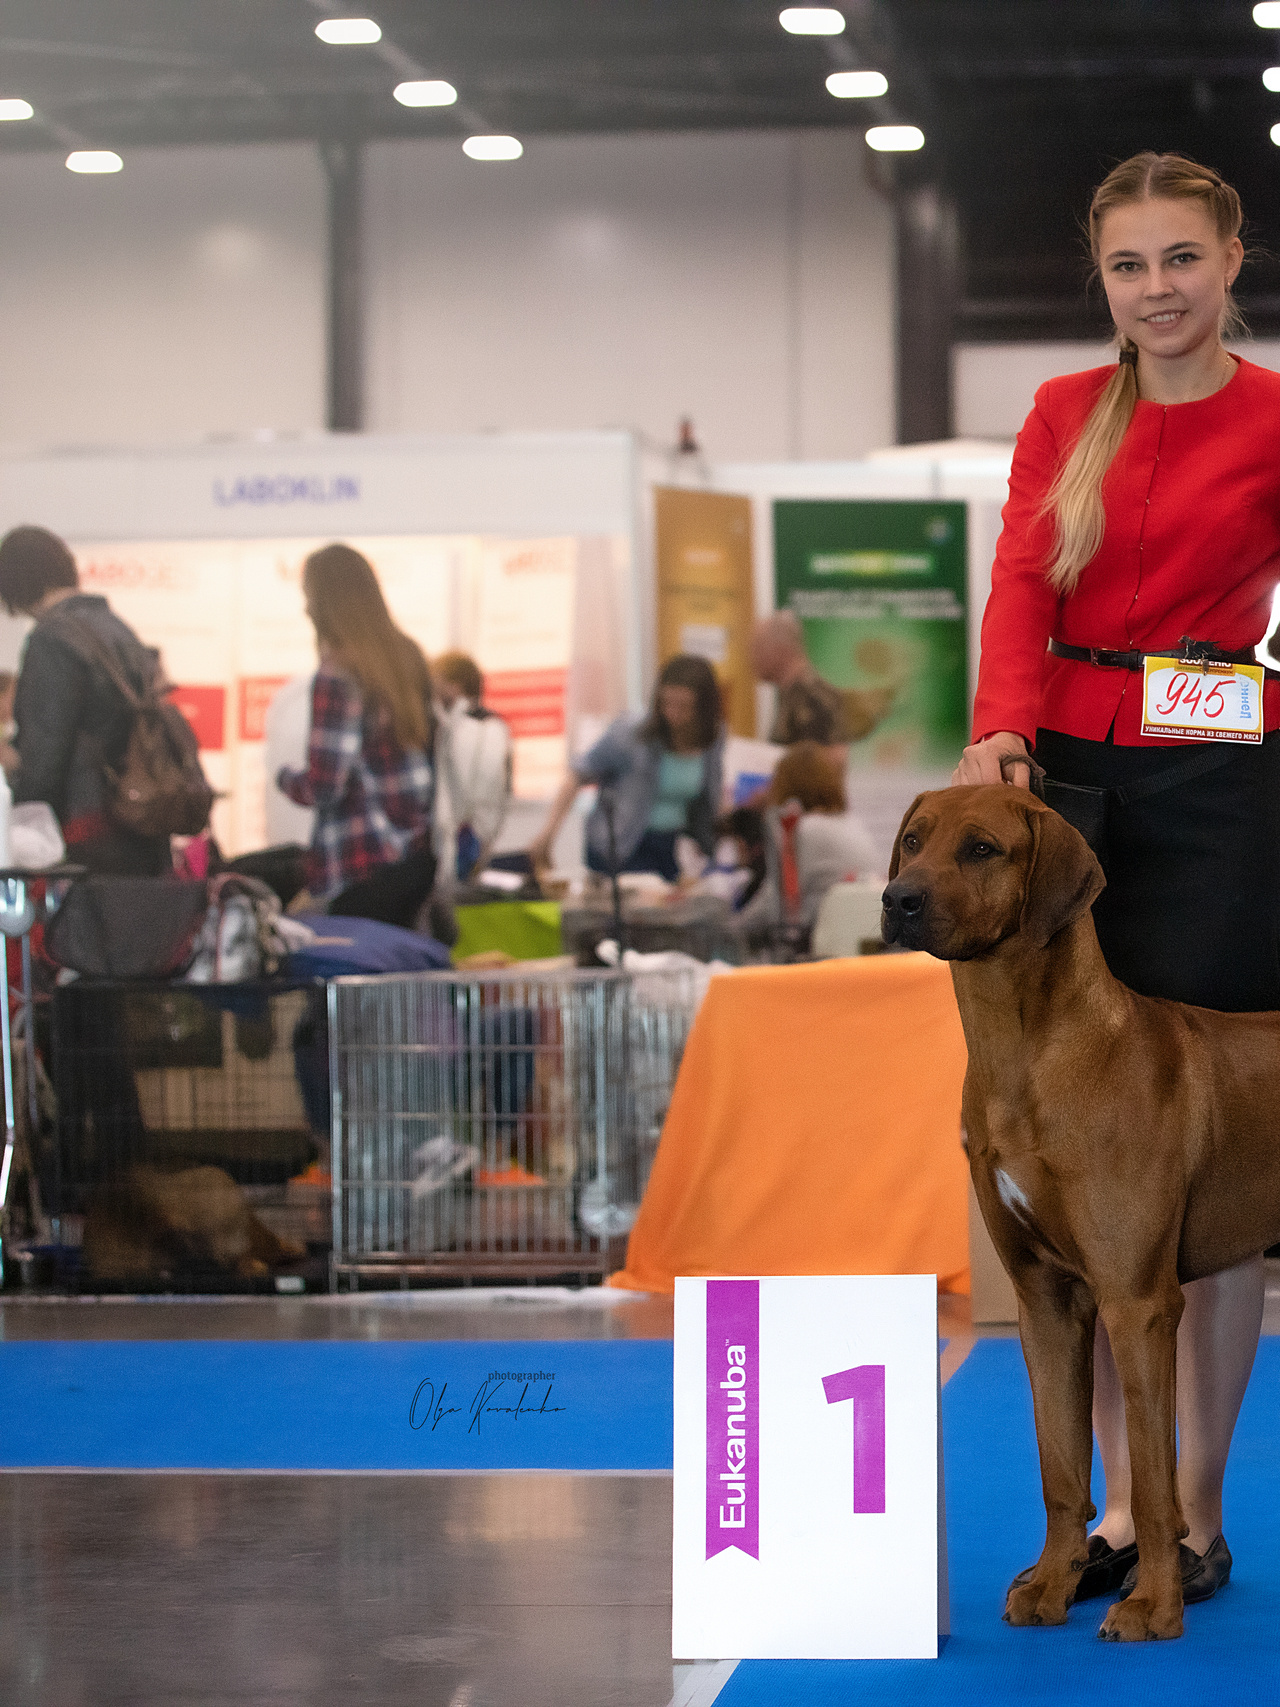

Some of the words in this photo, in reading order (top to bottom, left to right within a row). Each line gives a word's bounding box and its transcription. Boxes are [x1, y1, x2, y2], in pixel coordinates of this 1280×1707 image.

[213, 475, 361, 507] LABOKLIN
[1156, 672, 1236, 718] 945
[1145, 726, 1185, 734] УНИКАЛЬНЫЕ
[1186, 729, 1206, 737] КОРМА
[719, 1345, 747, 1529] Eukanuba
[821, 1365, 886, 1514] 1
